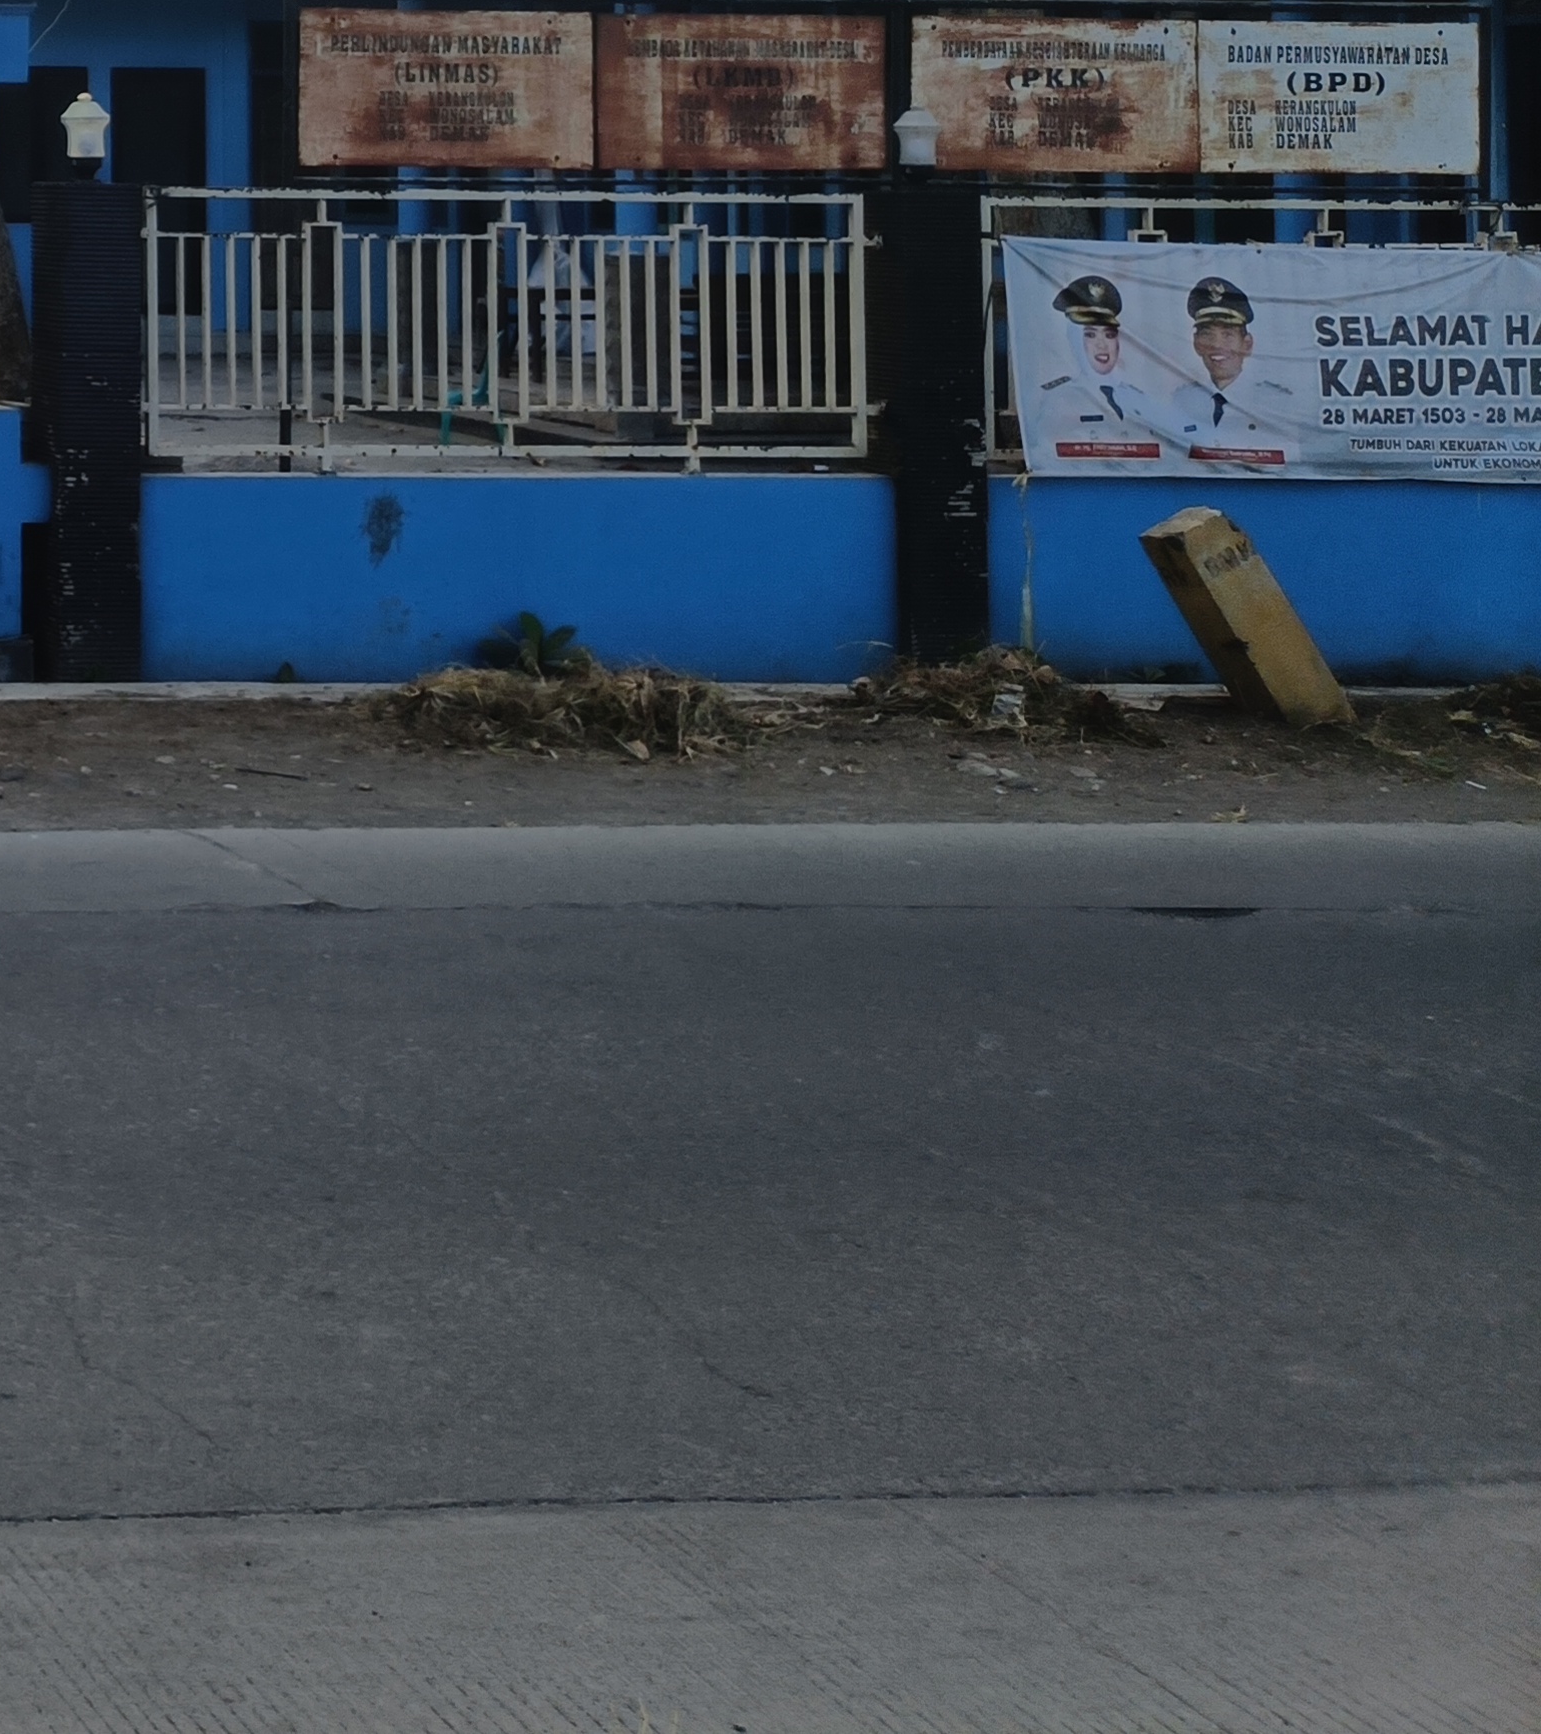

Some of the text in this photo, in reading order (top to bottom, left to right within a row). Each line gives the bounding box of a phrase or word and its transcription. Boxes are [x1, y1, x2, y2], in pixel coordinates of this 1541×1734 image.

[458, 35, 562, 56] MASYARAKAT
[1227, 44, 1449, 66] BADAN PERMUSYAWARATAN DESA
[394, 62, 500, 87] (LINMAS)
[1004, 66, 1104, 91] (PKK)
[1286, 71, 1386, 96] (BPD)
[1227, 99, 1357, 116] DESA KERANGKULON
[1227, 116, 1357, 133] KEC WONOSALAM
[1228, 133, 1334, 150] KAB DEMAK
[1314, 314, 1492, 347] SELAMAT
[1322, 408, 1345, 425] 28
[1352, 408, 1415, 425] MARET
[1422, 407, 1466, 424] 1503
[1486, 407, 1507, 424] 28
[1350, 438, 1402, 450] TUMBUH
[1406, 439, 1435, 451] DARI
[1439, 439, 1507, 452] KEKUATAN
[1433, 458, 1479, 469] UNTUK
